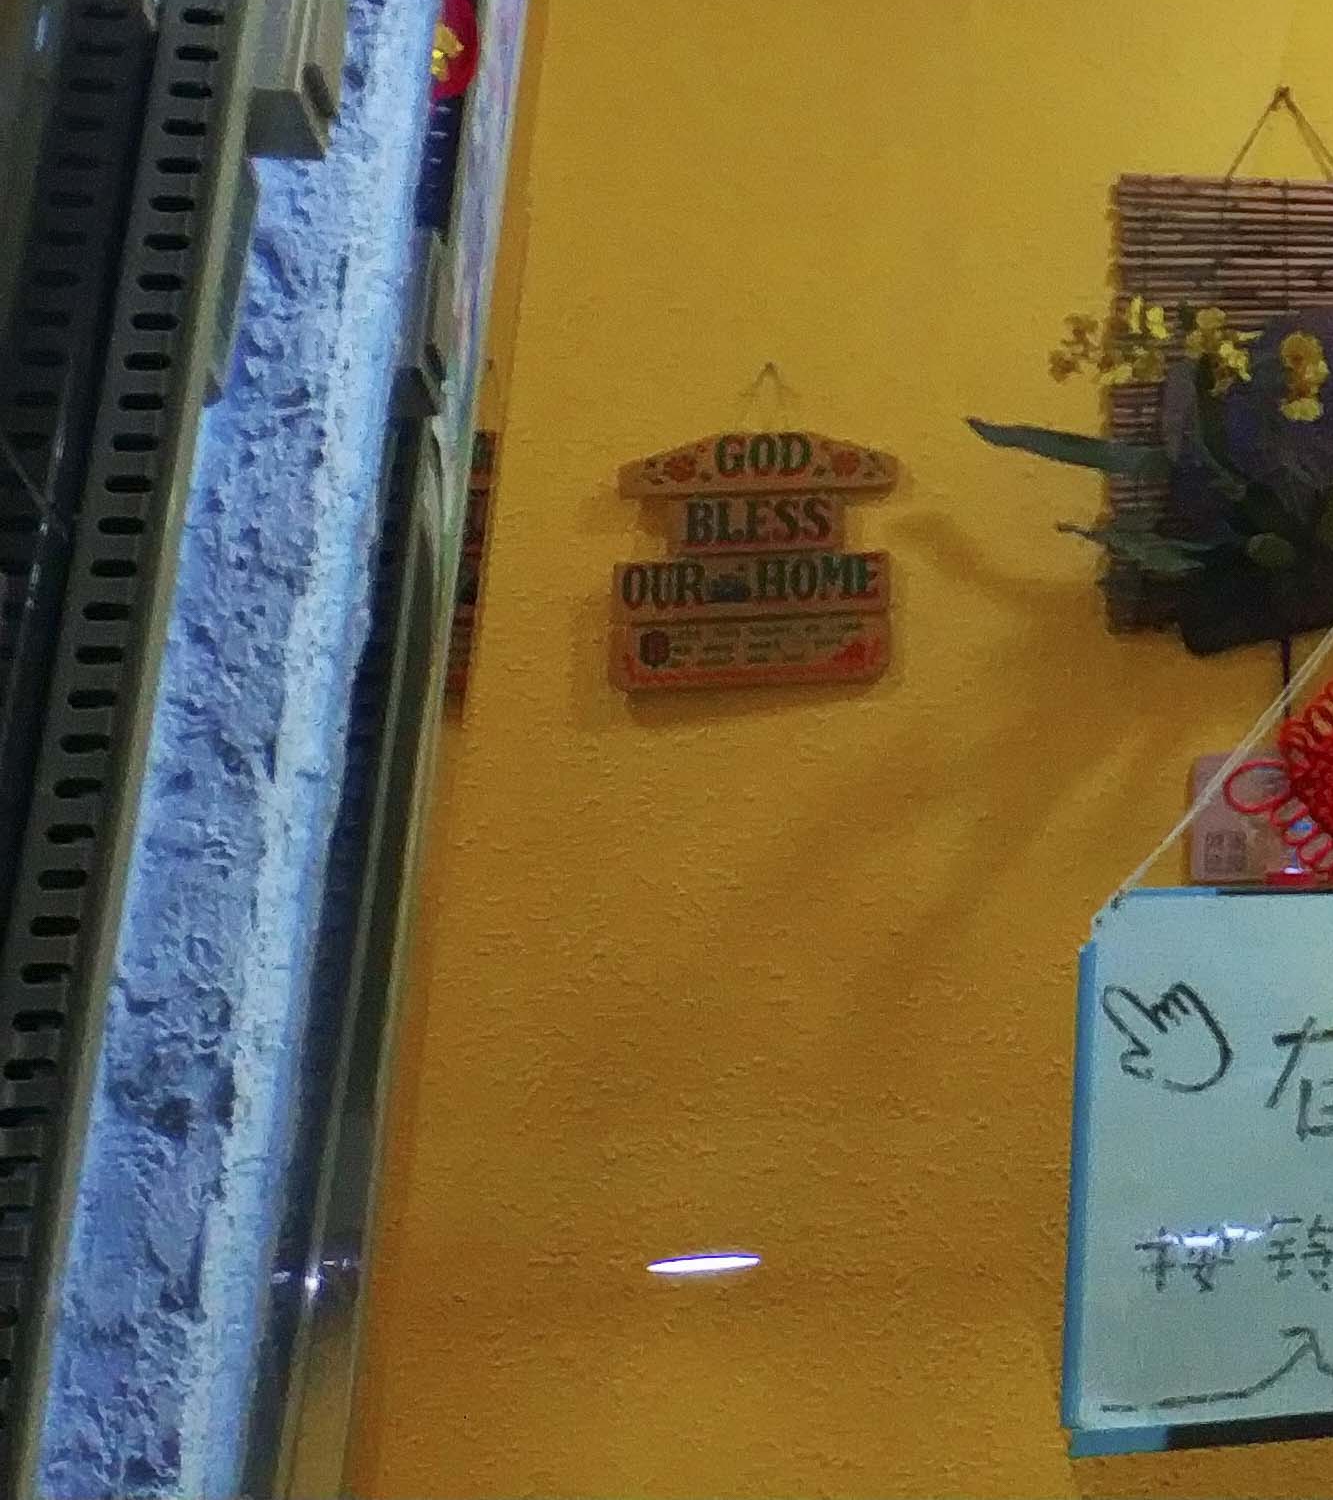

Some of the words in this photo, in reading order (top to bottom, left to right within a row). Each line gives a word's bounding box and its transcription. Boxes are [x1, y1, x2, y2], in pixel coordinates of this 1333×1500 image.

[714, 432, 814, 478] GOD
[686, 498, 834, 546] BLESS
[621, 562, 706, 611] OUR
[756, 552, 881, 602] HOME
